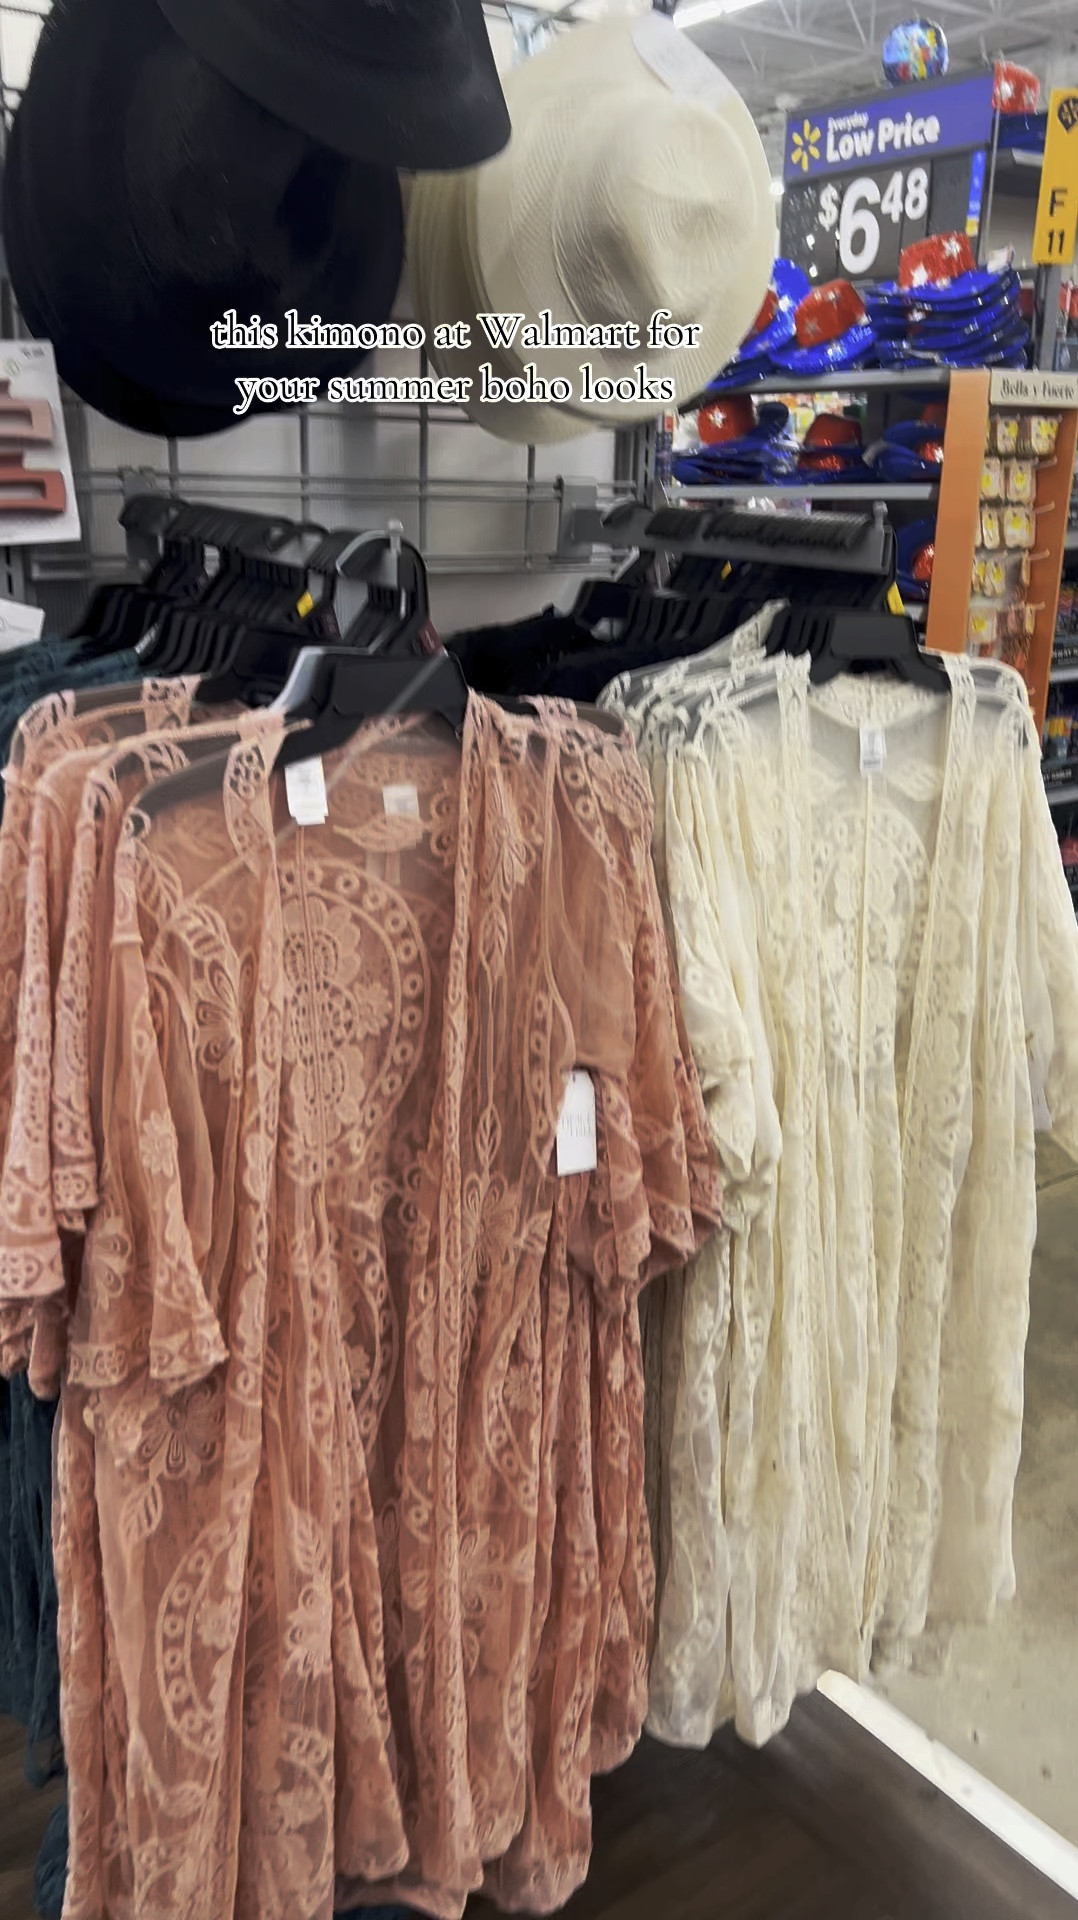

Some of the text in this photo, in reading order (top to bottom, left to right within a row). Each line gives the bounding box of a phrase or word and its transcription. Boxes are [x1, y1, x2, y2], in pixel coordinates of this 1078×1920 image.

[826, 111, 940, 163] Low Price
[1049, 188, 1069, 217] F
[1047, 229, 1065, 255] 11
